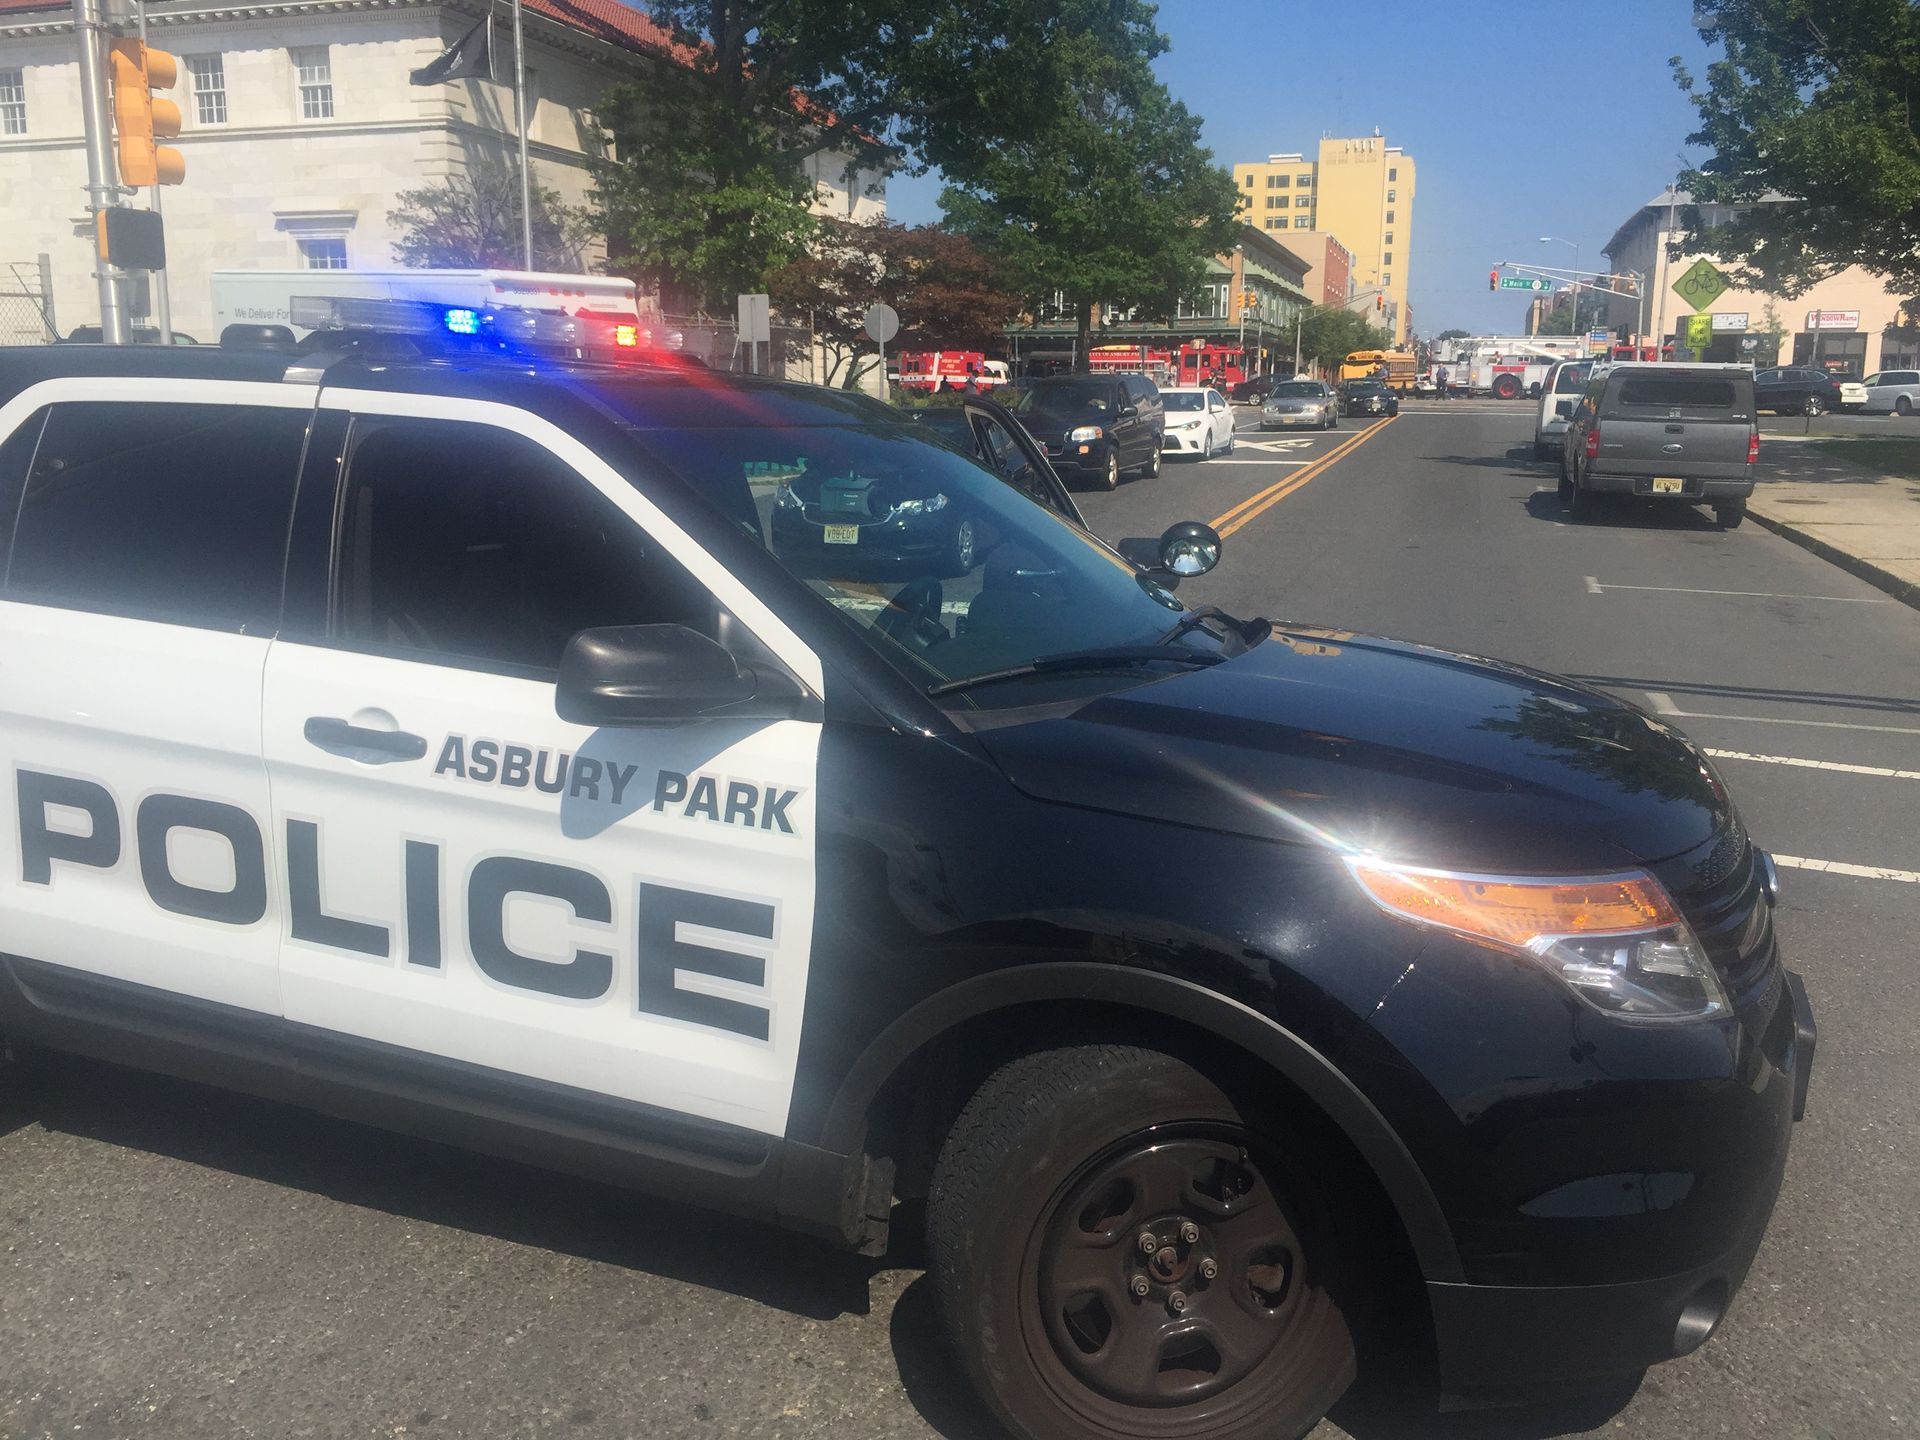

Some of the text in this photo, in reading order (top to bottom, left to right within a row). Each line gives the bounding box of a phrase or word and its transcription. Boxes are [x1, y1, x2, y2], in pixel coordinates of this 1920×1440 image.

[1508, 280, 1523, 288] Main
[234, 307, 290, 319] We Deliver For
[434, 735, 800, 834] ASBURY PARK
[15, 768, 777, 1043] POLICE
